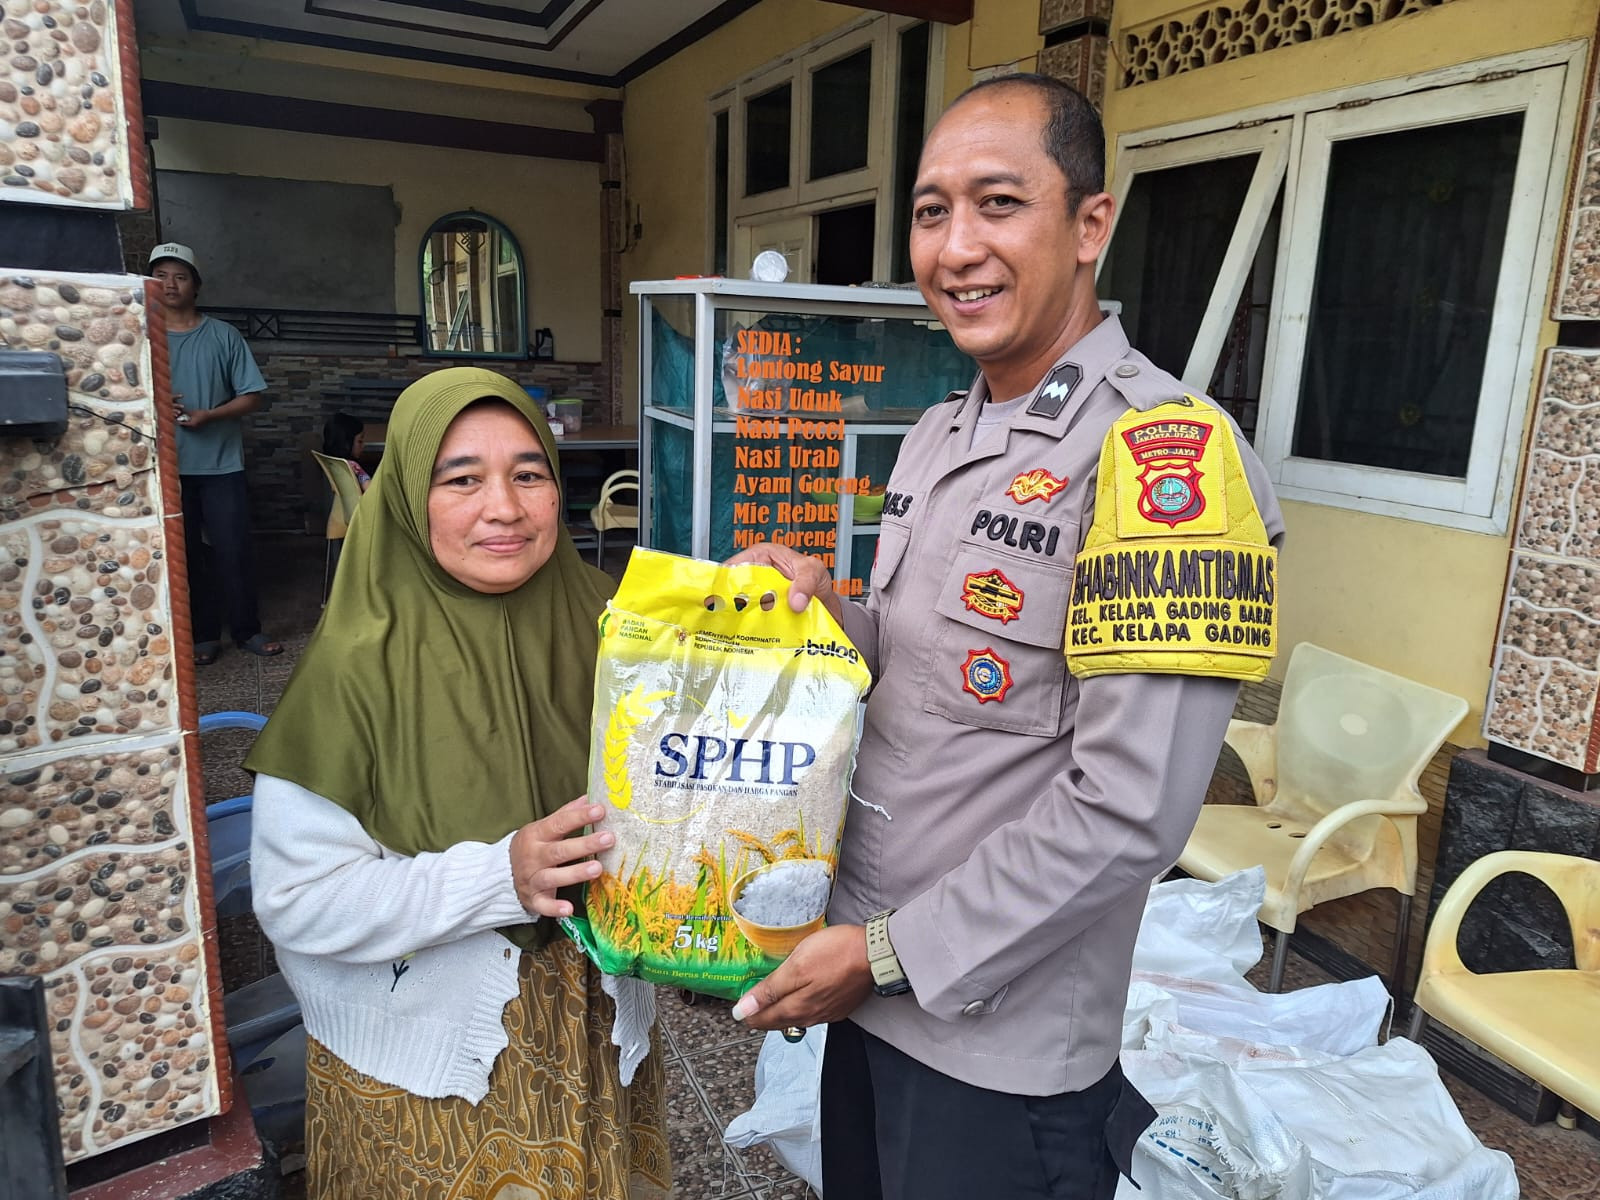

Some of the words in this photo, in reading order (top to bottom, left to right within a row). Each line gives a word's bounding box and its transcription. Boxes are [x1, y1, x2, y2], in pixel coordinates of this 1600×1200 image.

[737, 357, 822, 383] Lontong
[829, 361, 885, 384] Sayur
[737, 387, 782, 410] Nasi
[790, 388, 842, 412] Uduk
[736, 416, 781, 440] Nasi
[787, 418, 845, 441] Pecel
[1134, 424, 1199, 438] POLRES
[735, 446, 781, 468] Nasi
[789, 447, 840, 468] Urab
[1141, 448, 1168, 459] METRO
[1173, 448, 1195, 456] JAYA
[733, 474, 791, 495] Ayam
[799, 475, 871, 496] Goreng
[733, 502, 770, 525] Mie
[776, 502, 840, 524] Rebus
[733, 529, 766, 549] Mie
[771, 528, 836, 549] Goreng
[971, 510, 1060, 557] POLRI
[1072, 549, 1274, 606] BHABINKAMTIBMAS
[1071, 606, 1093, 626] KEL.
[1100, 602, 1156, 621] KELAPA
[1166, 601, 1231, 621] GADING
[619, 632, 653, 641] NASIONAL
[736, 633, 781, 643] KOORDINATOR
[1072, 626, 1103, 646] KEC.
[1113, 623, 1191, 642] KELAPA
[1205, 624, 1272, 647] GADING
[694, 643, 722, 652] REPUBLIK
[807, 639, 858, 664] bulog
[655, 732, 816, 786] SPHP
[674, 925, 692, 948] 5
[696, 934, 718, 952] kg
[671, 970, 699, 979] Beras
